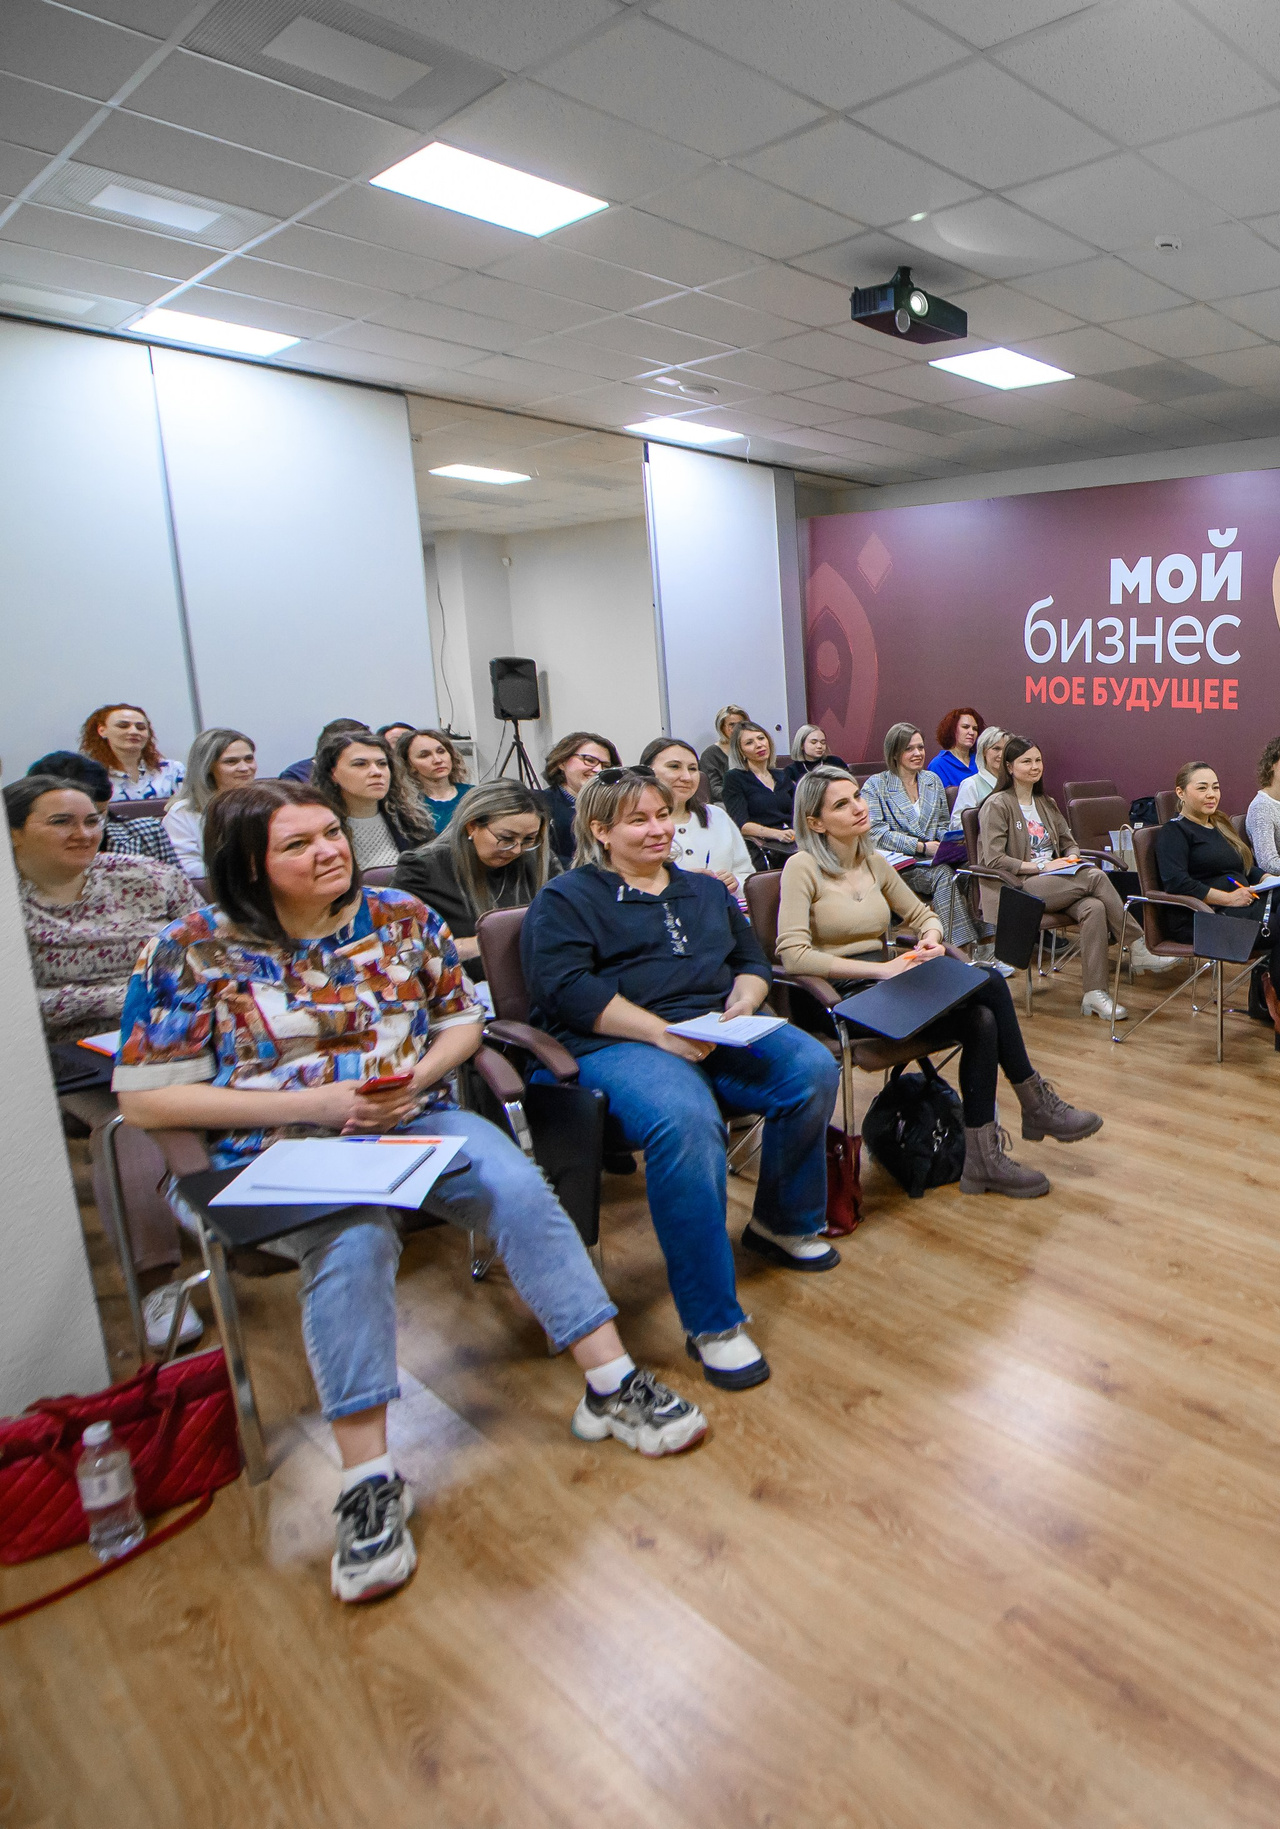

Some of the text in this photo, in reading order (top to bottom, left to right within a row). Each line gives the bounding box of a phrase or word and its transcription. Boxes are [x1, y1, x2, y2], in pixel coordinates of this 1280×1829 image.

[1024, 594, 1242, 665] бизнес
[1025, 675, 1239, 714] МОЕ БУДУЩЕЕ
